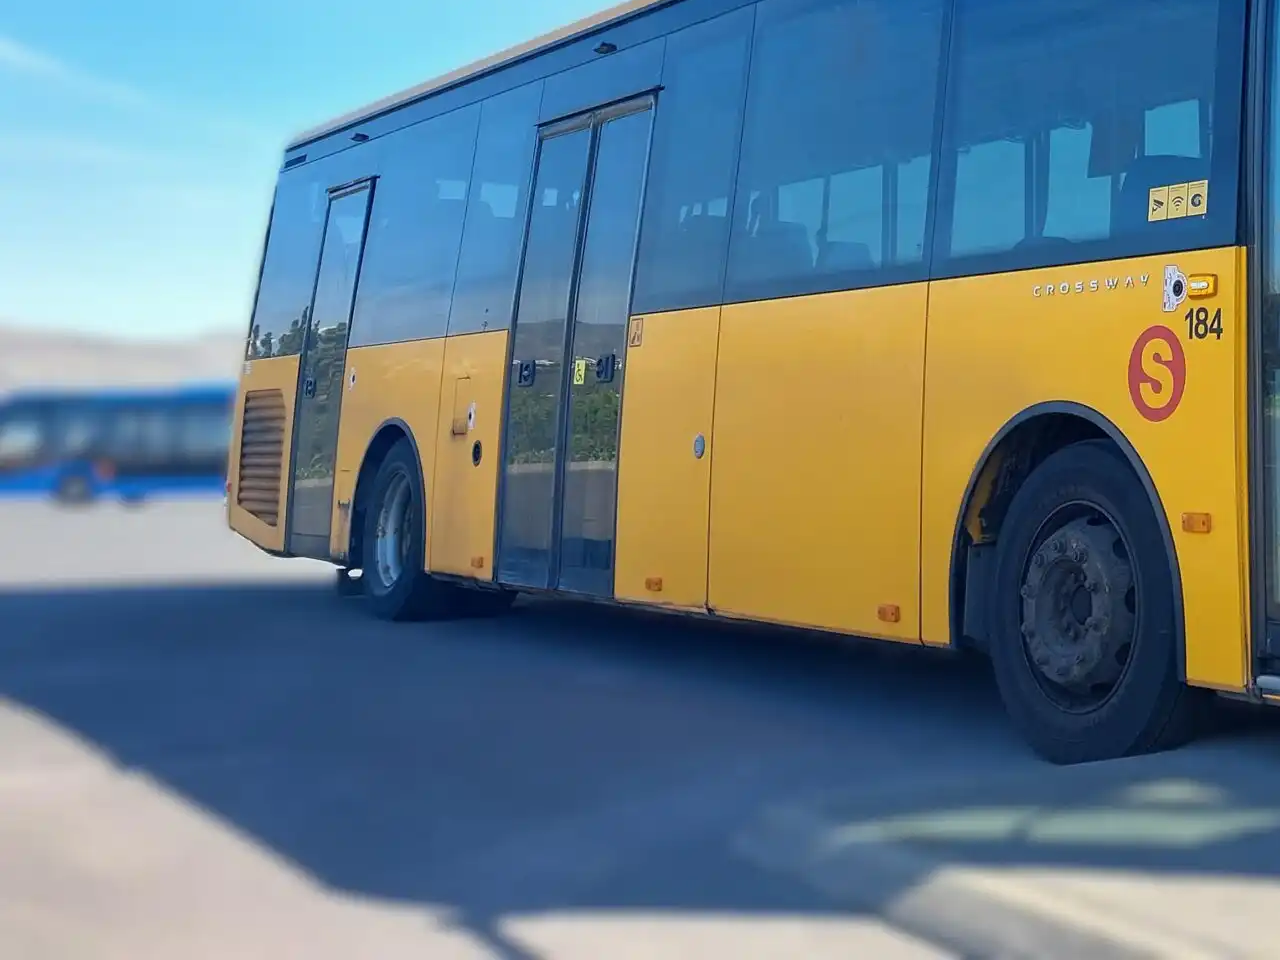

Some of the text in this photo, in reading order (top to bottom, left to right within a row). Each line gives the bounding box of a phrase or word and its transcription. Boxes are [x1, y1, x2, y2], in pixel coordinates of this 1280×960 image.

[1033, 272, 1150, 297] CROSSWAY
[1184, 307, 1223, 340] 184
[1138, 336, 1176, 411] S
